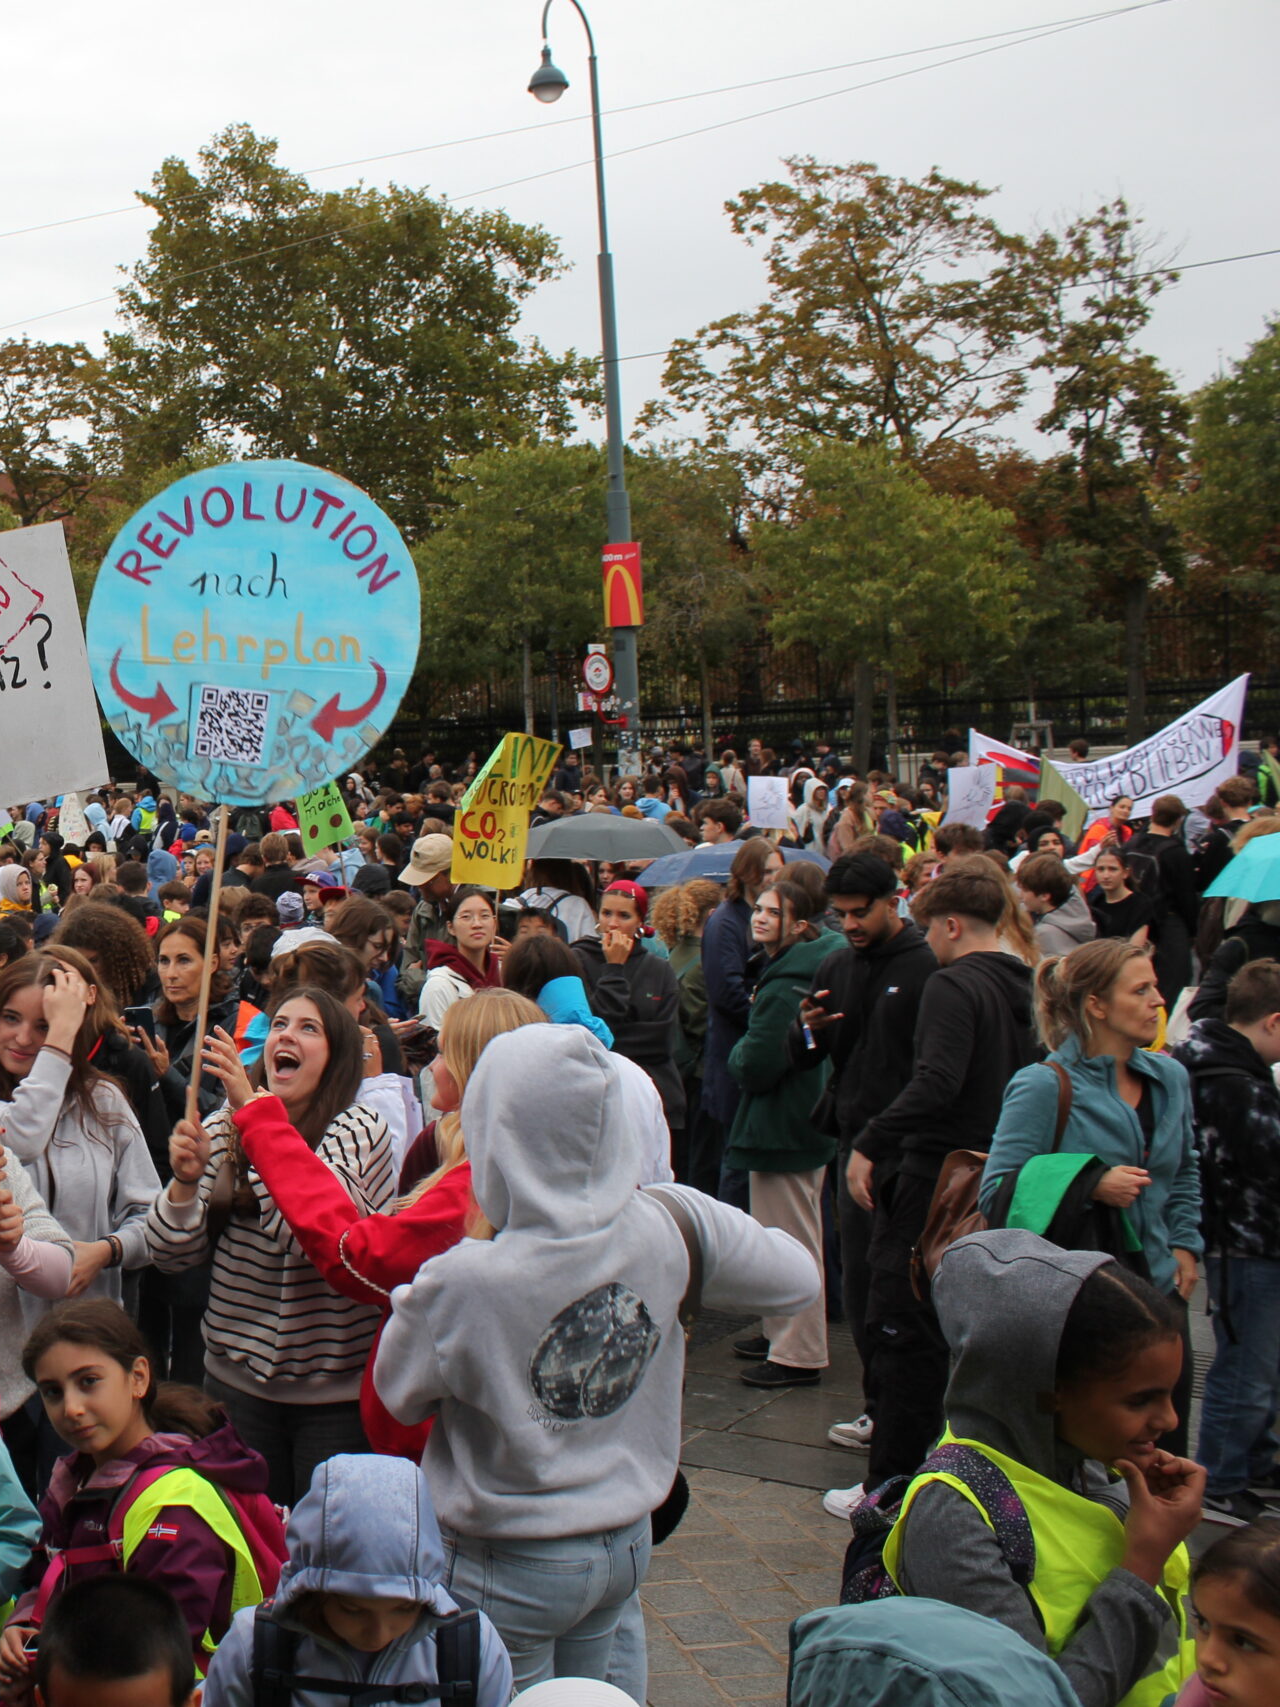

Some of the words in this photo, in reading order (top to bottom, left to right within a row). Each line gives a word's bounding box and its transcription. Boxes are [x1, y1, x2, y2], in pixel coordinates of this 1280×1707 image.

[114, 482, 401, 595] REVOLUTION
[189, 551, 289, 599] nach
[140, 603, 362, 681] Lehrplan
